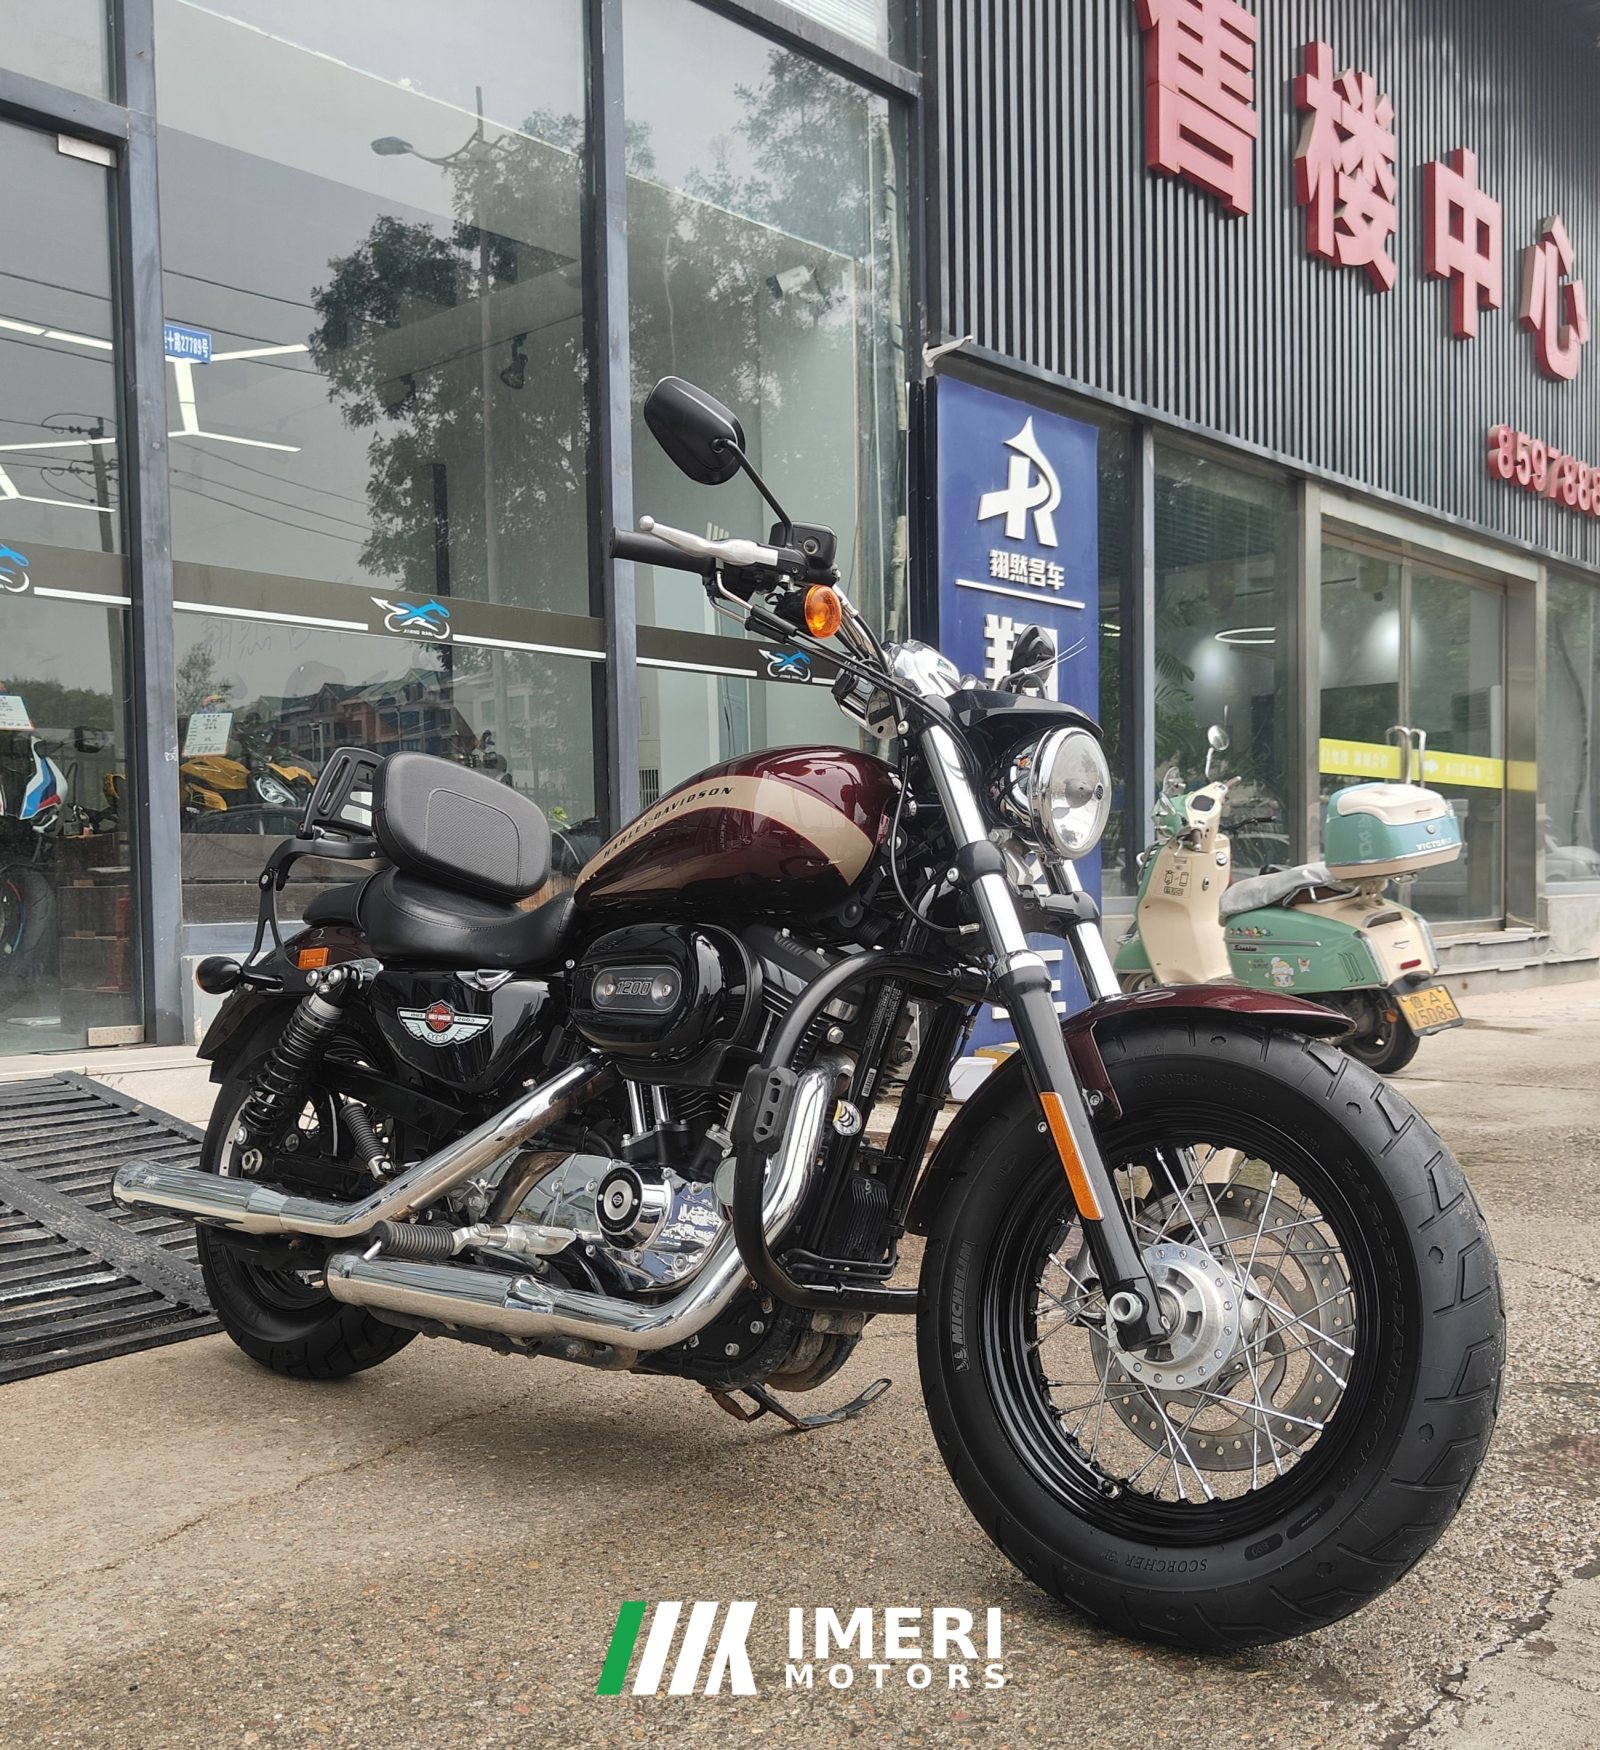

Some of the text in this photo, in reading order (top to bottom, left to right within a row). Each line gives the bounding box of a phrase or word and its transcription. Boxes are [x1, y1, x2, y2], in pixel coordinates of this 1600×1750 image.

[1135, 0, 1589, 381] 售楼中心
[989, 549, 1065, 590] 翔然名车
[603, 786, 735, 859] HARLEY-DAVIDSON
[616, 981, 652, 996] 1200
[951, 1240, 975, 1345] MICHELIN
[1124, 1553, 1208, 1573] SCORCHER
